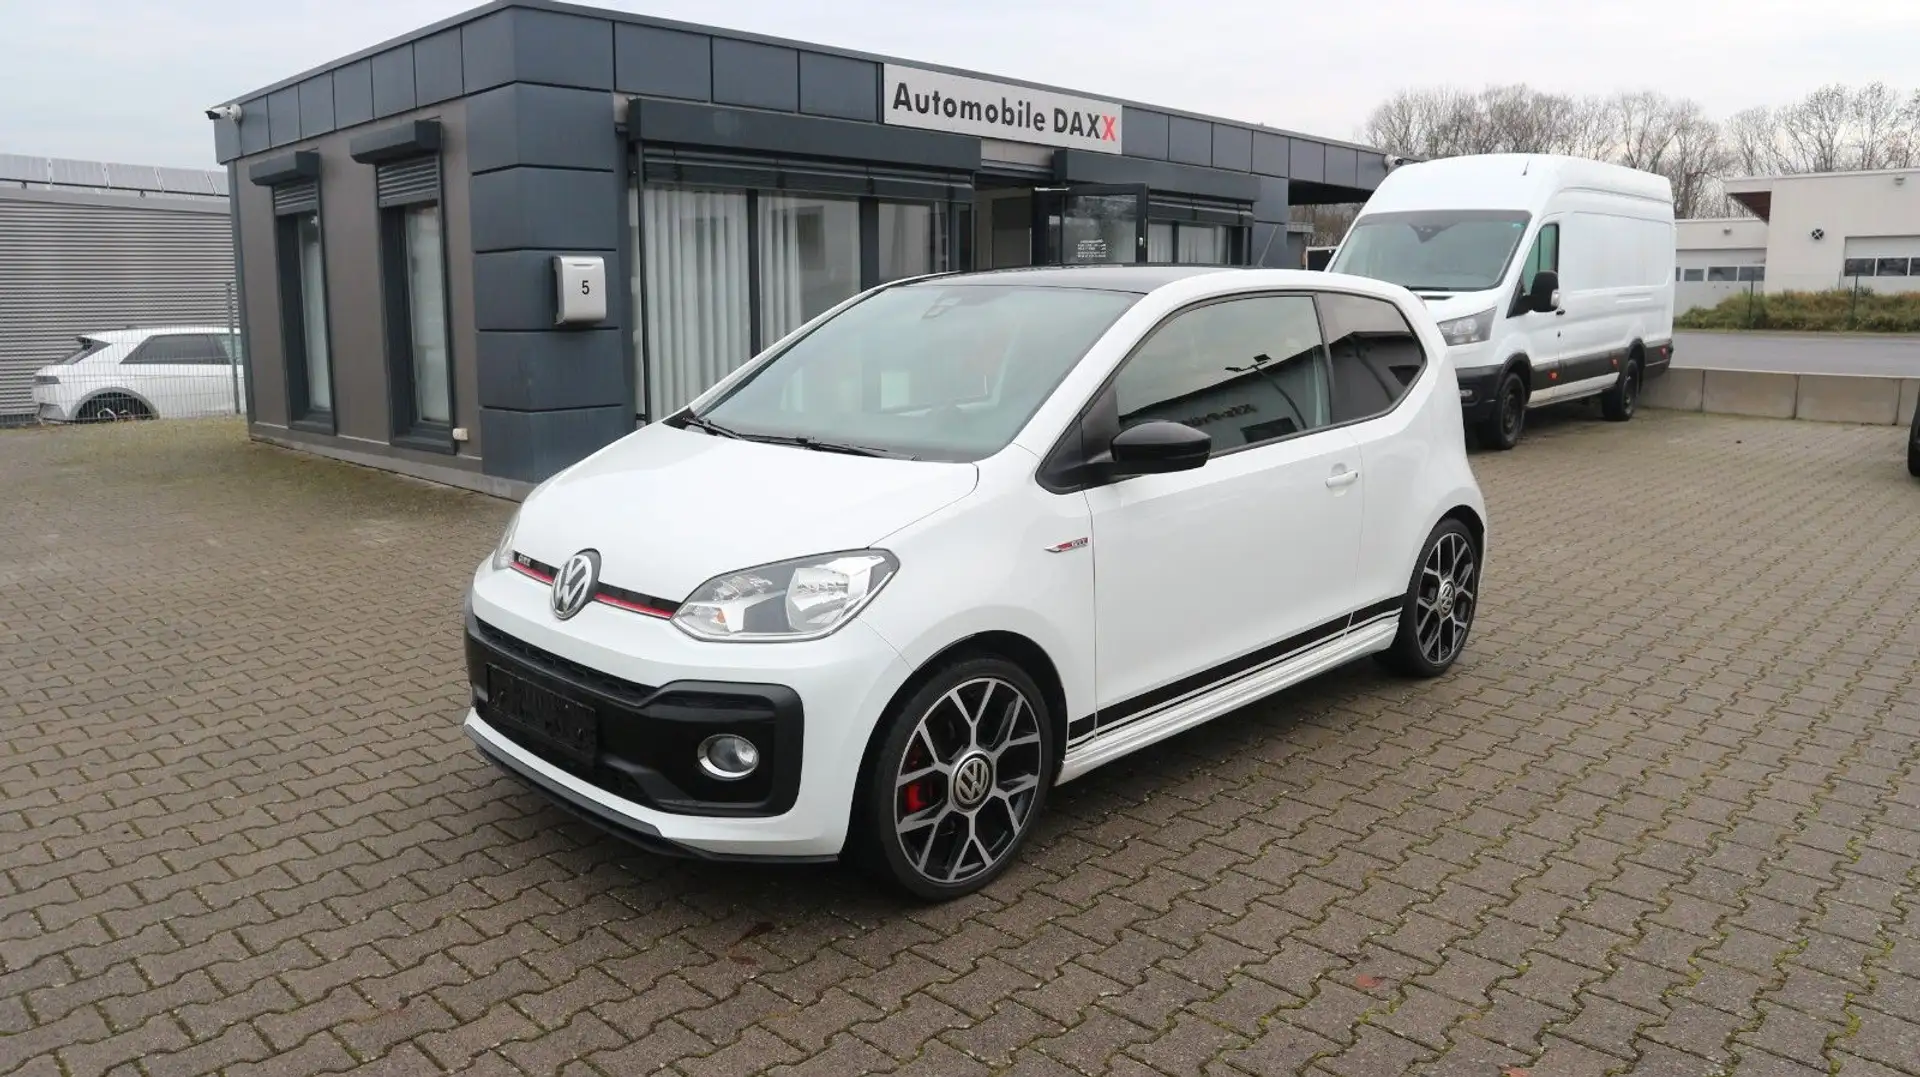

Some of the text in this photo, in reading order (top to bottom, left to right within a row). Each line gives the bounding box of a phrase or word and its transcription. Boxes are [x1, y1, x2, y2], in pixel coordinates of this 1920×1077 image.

[893, 82, 1116, 142] Automobile DAXX
[581, 280, 590, 295] 5
